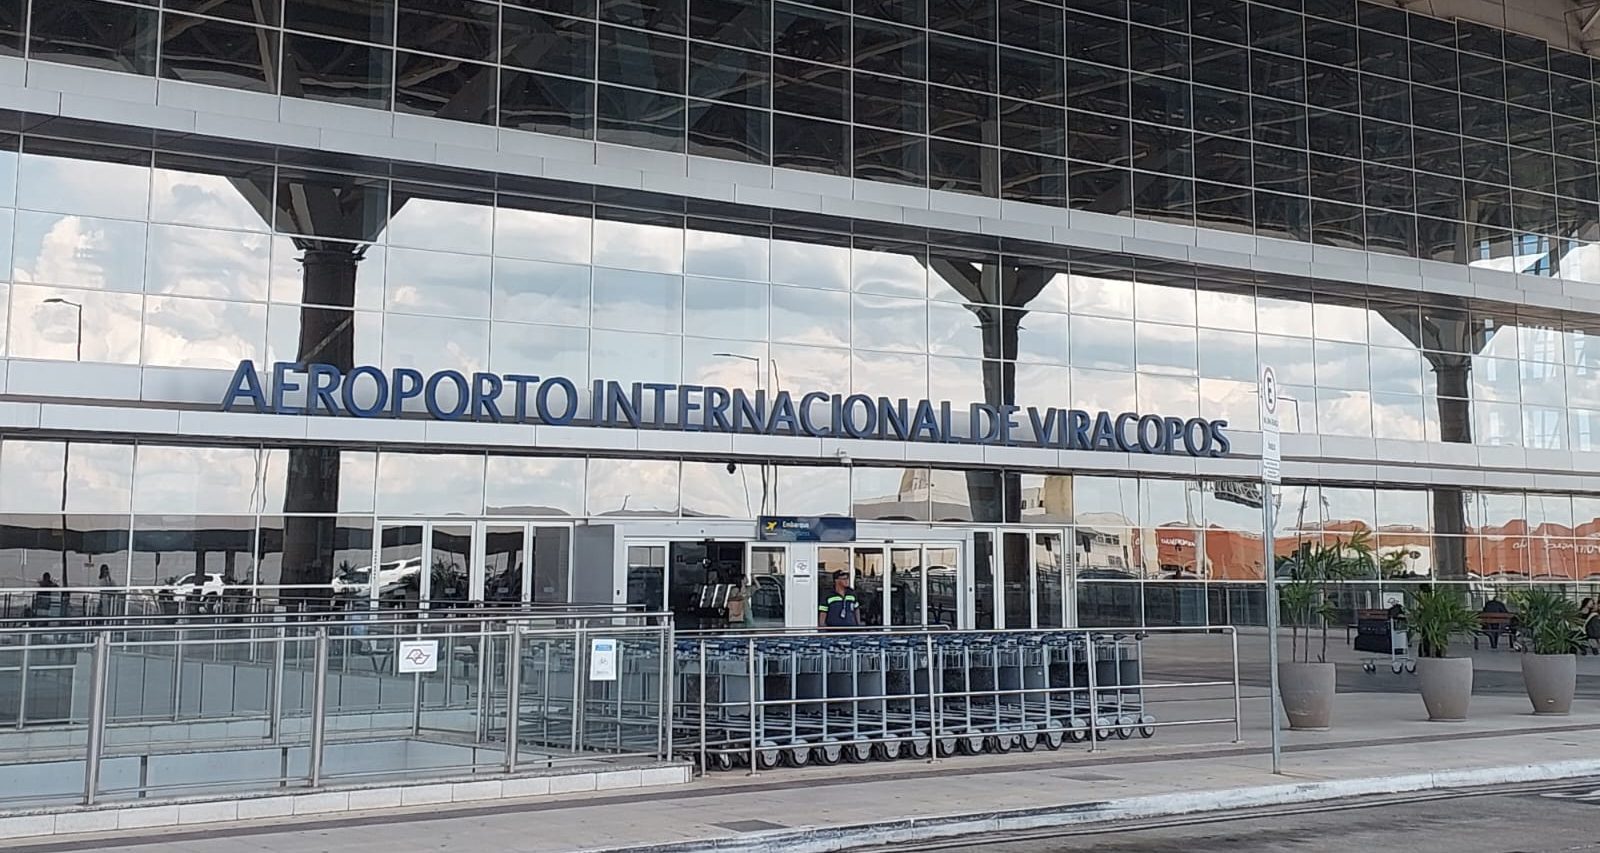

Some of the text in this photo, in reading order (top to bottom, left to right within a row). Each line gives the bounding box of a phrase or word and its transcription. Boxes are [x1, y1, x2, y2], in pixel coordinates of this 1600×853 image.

[222, 359, 1231, 457] AEROPORTO INTERNACIONAL DE VIRACOPOS
[1266, 377, 1275, 405] E
